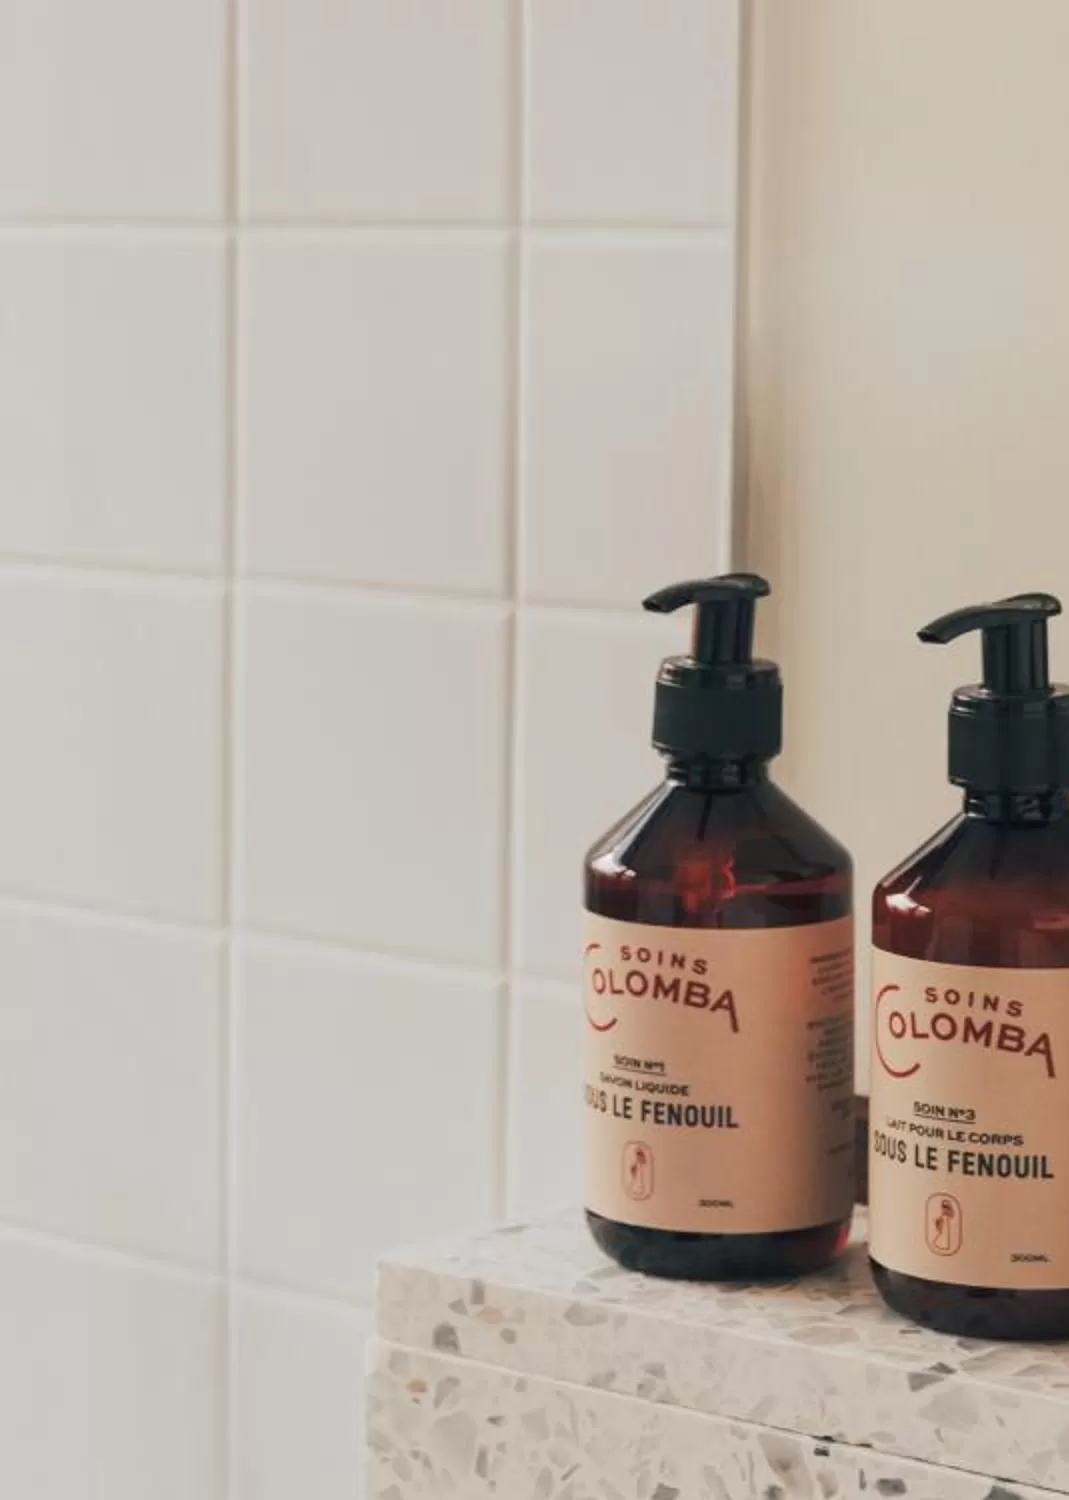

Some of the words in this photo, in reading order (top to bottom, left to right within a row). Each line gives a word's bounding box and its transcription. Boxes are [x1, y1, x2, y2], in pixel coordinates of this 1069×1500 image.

[621, 946, 708, 975] SOINS
[924, 987, 1024, 1018] SOINS
[875, 984, 1056, 1079] COLOMBA
[635, 1080, 691, 1097] LIQUIDE
[612, 1093, 633, 1120] LE
[640, 1099, 740, 1129] FENOUIL
[914, 1101, 945, 1117] SOIN
[909, 1123, 945, 1140] POUR
[947, 1130, 966, 1143] LE
[968, 1132, 1024, 1146] CORPS
[915, 1144, 938, 1171] LE
[947, 1149, 1055, 1179] FENOUIL
